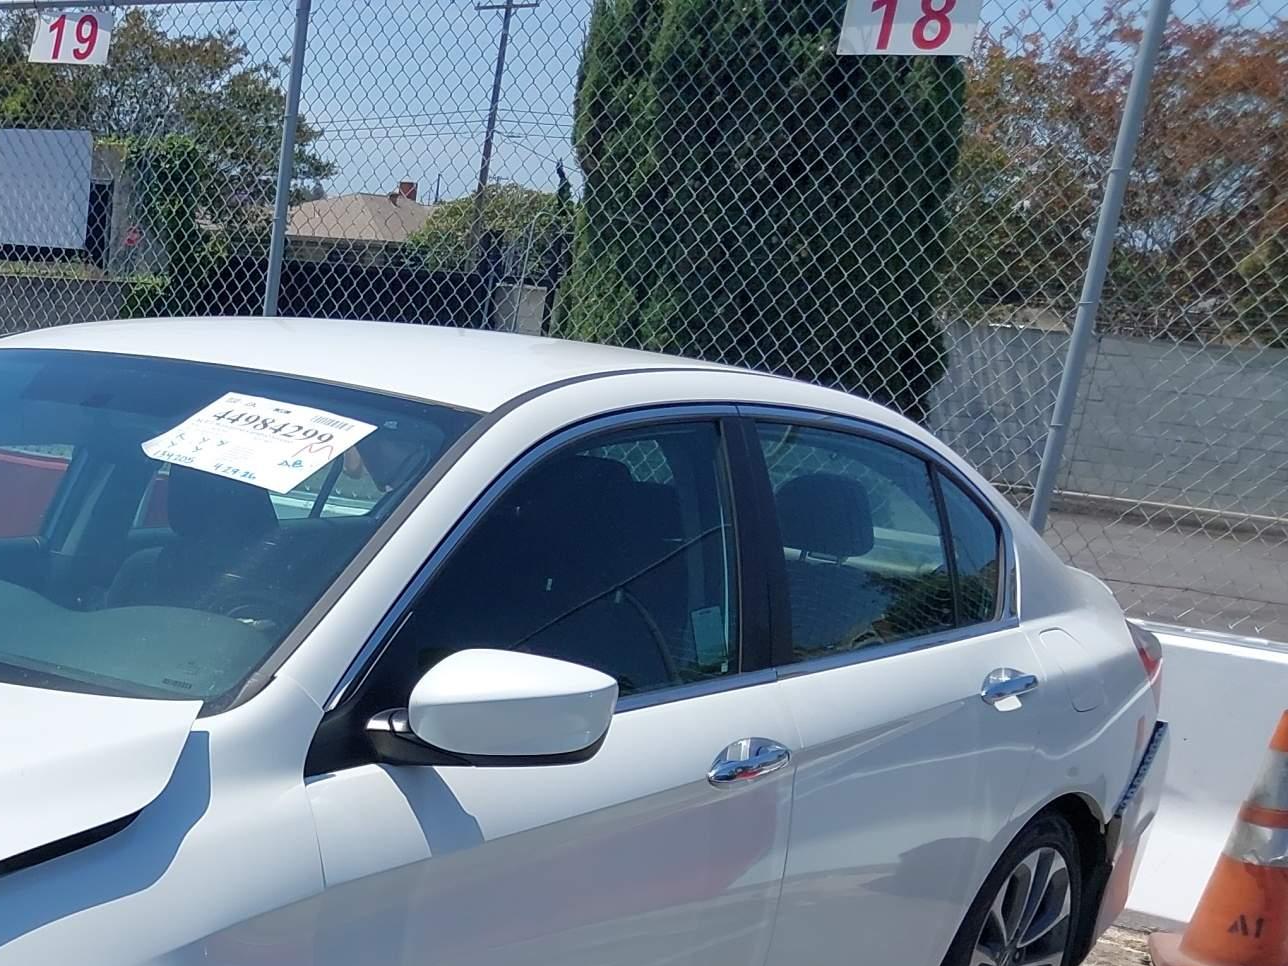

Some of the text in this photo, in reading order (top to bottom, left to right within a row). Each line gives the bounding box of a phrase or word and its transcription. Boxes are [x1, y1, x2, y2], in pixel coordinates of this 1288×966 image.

[49, 14, 98, 60] 19
[871, 0, 957, 50] 18
[213, 409, 334, 444] 44984299
